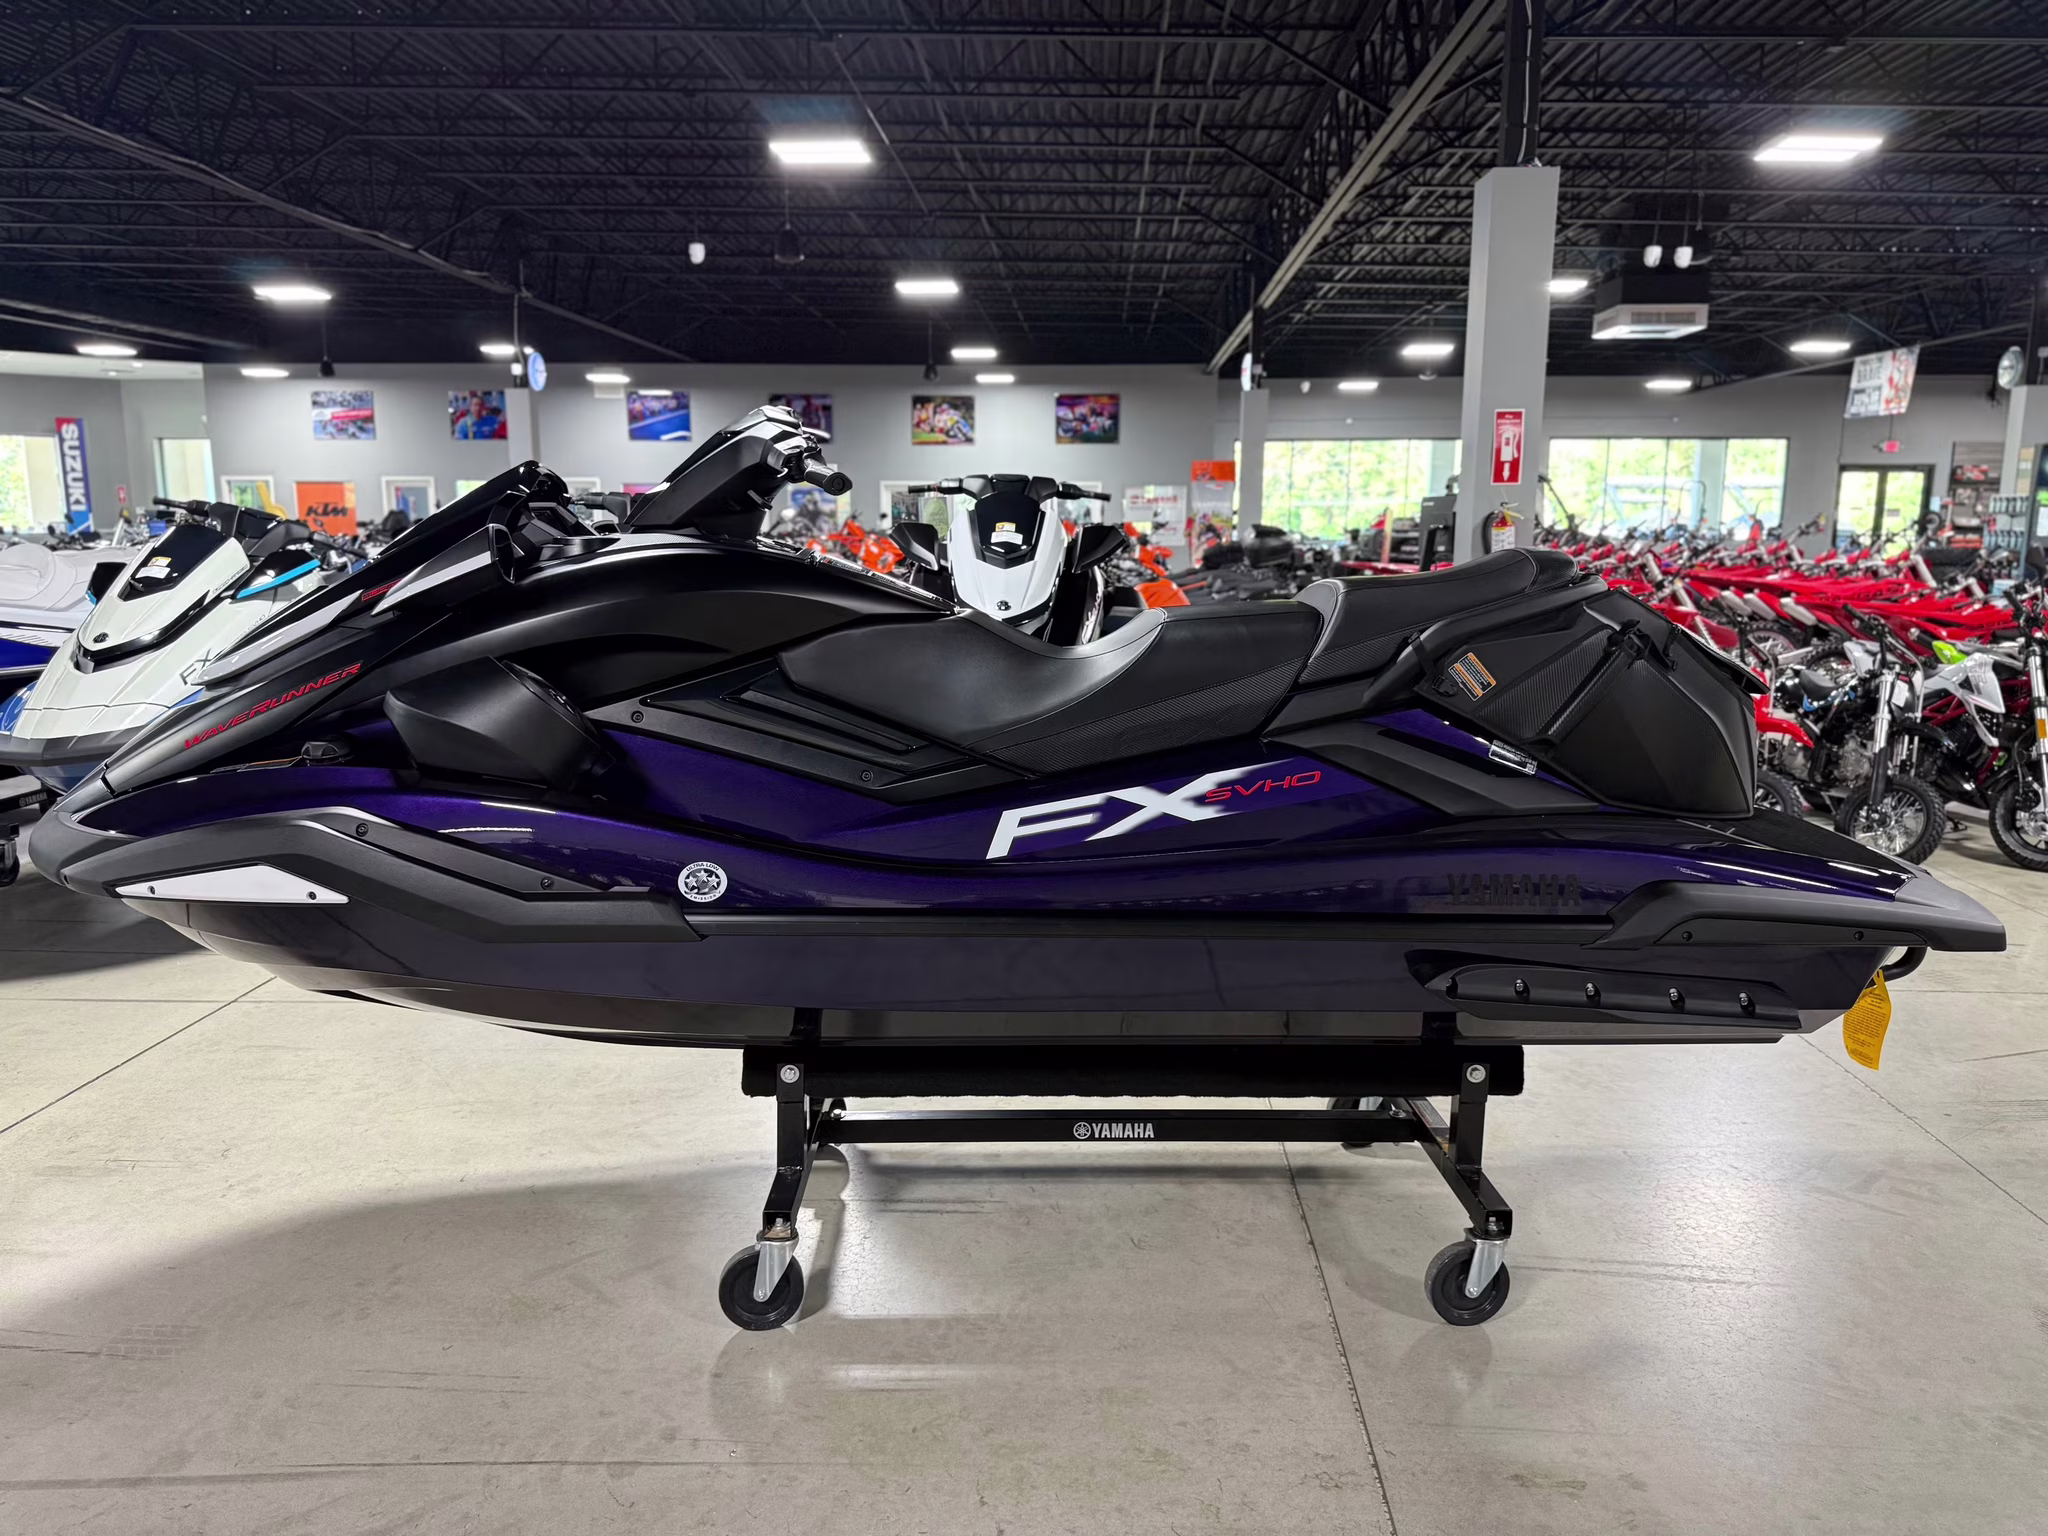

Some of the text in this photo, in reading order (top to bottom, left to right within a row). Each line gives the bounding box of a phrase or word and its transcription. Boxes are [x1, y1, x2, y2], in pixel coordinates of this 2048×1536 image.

[61, 422, 87, 511] SUZUKI
[306, 503, 349, 517] KTM
[985, 758, 1322, 860] FX SVHO
[686, 863, 705, 872] ULTRA
[1447, 873, 1582, 906] YAMAHA
[1092, 1123, 1155, 1139] YAMAHA
